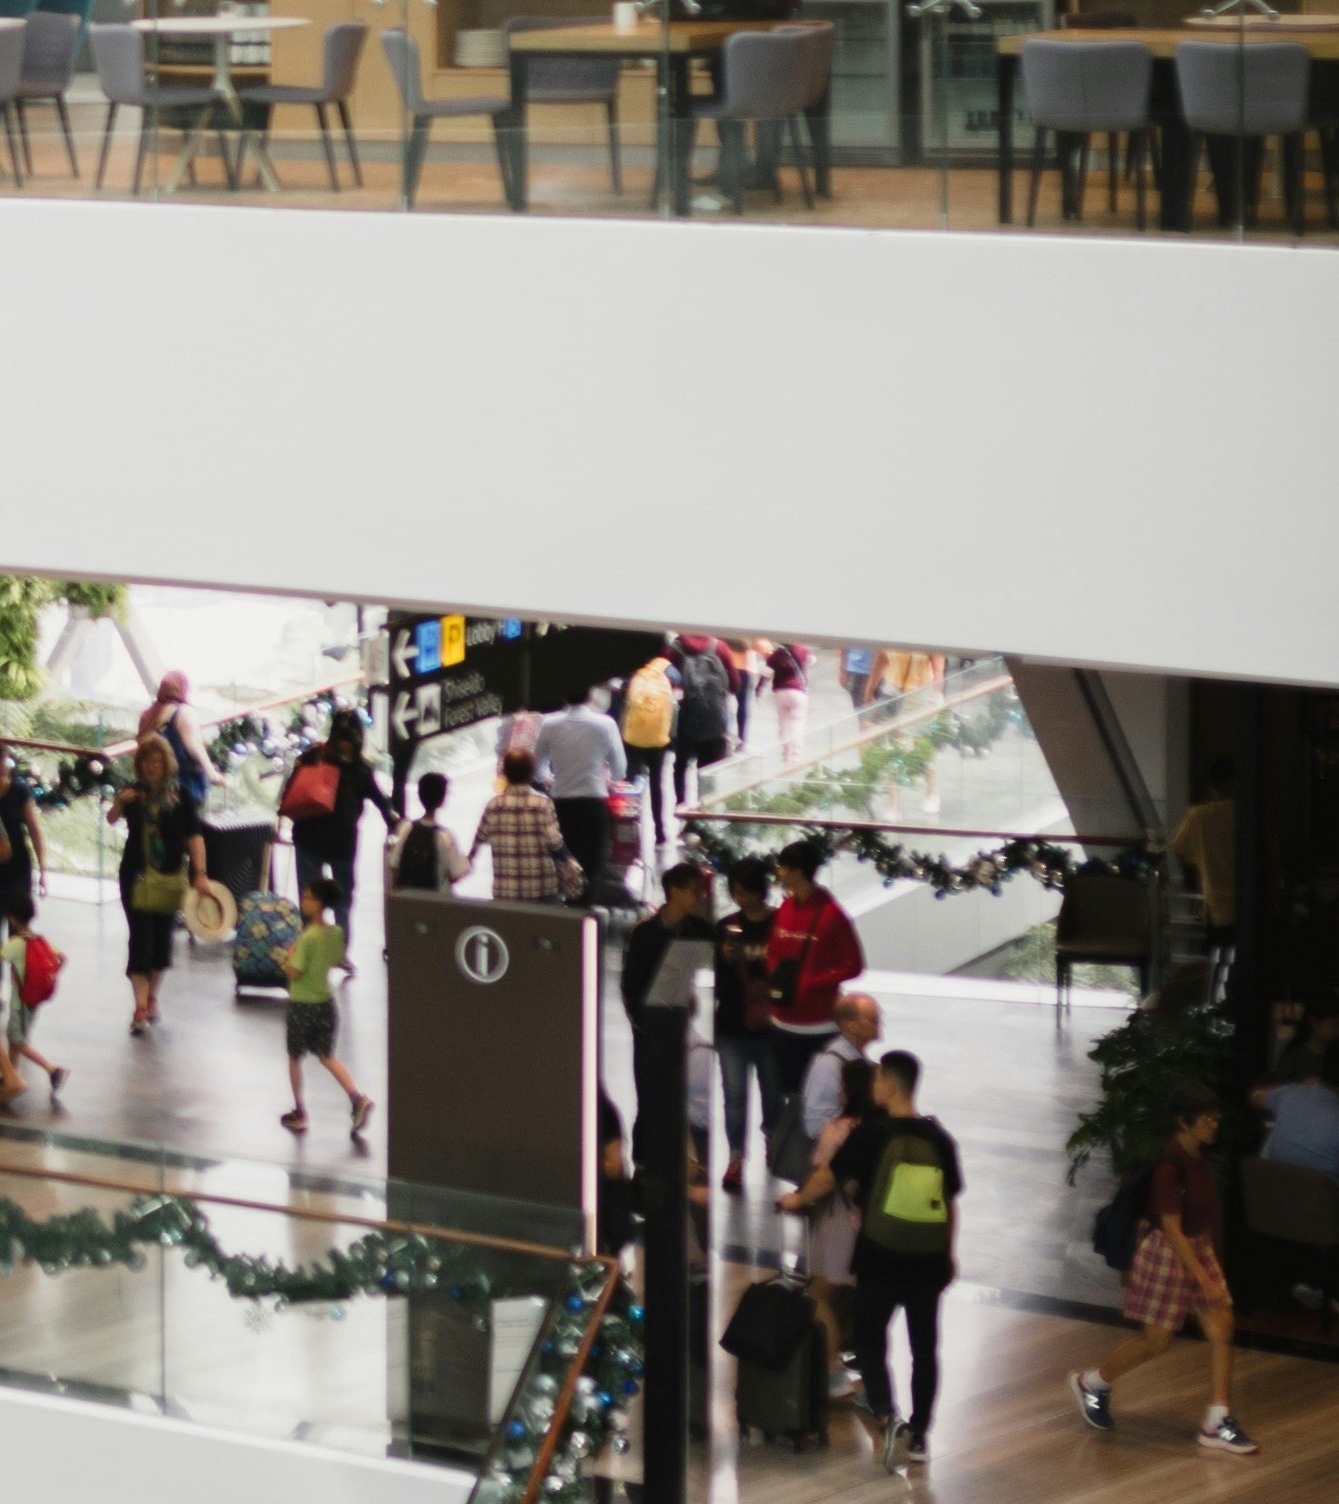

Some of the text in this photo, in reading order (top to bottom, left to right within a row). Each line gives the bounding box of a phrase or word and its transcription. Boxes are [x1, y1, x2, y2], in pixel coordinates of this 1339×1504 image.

[466, 620, 496, 646] Lobby
[444, 692, 503, 727] Forest Valley
